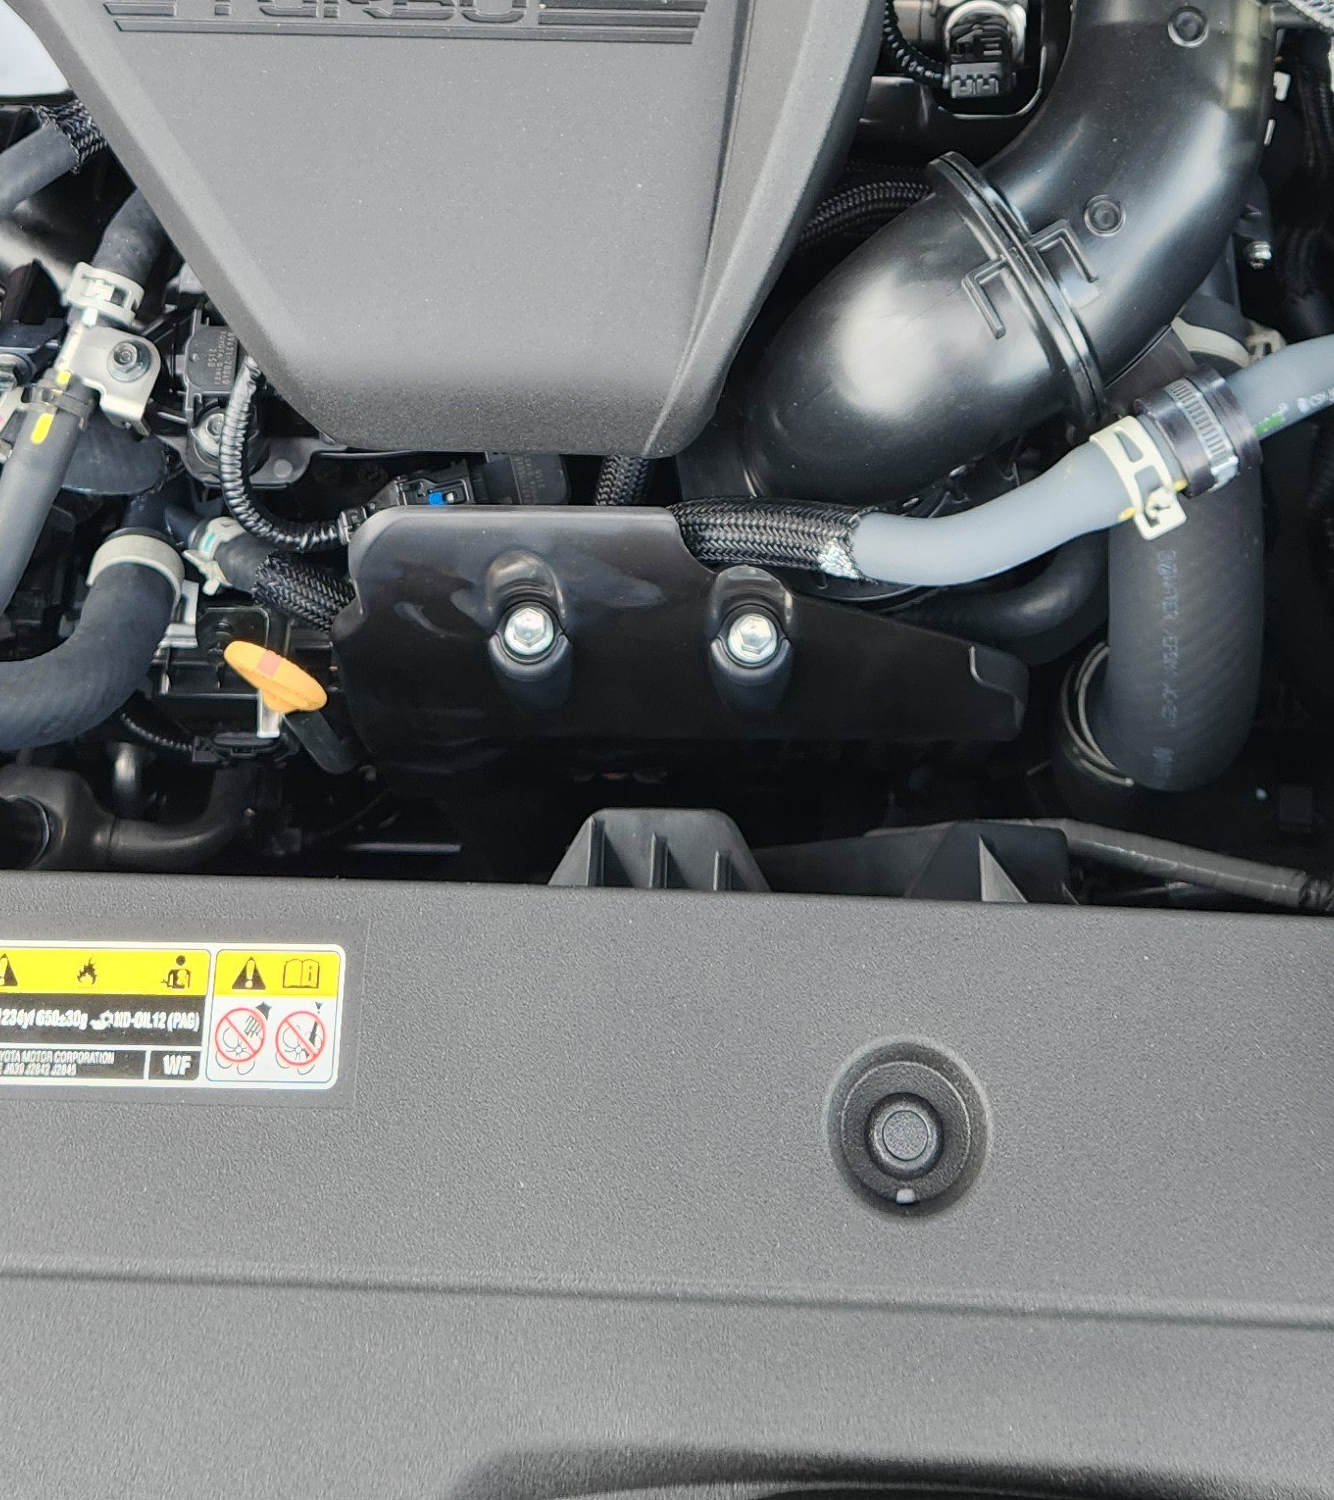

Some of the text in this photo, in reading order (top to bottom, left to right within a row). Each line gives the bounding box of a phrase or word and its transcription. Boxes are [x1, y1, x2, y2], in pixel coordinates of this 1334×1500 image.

[166, 1012, 201, 1033] (PAG)
[21, 1050, 53, 1063] MOTOR
[53, 1050, 115, 1065] CORPORATION
[162, 1054, 192, 1076] WF
